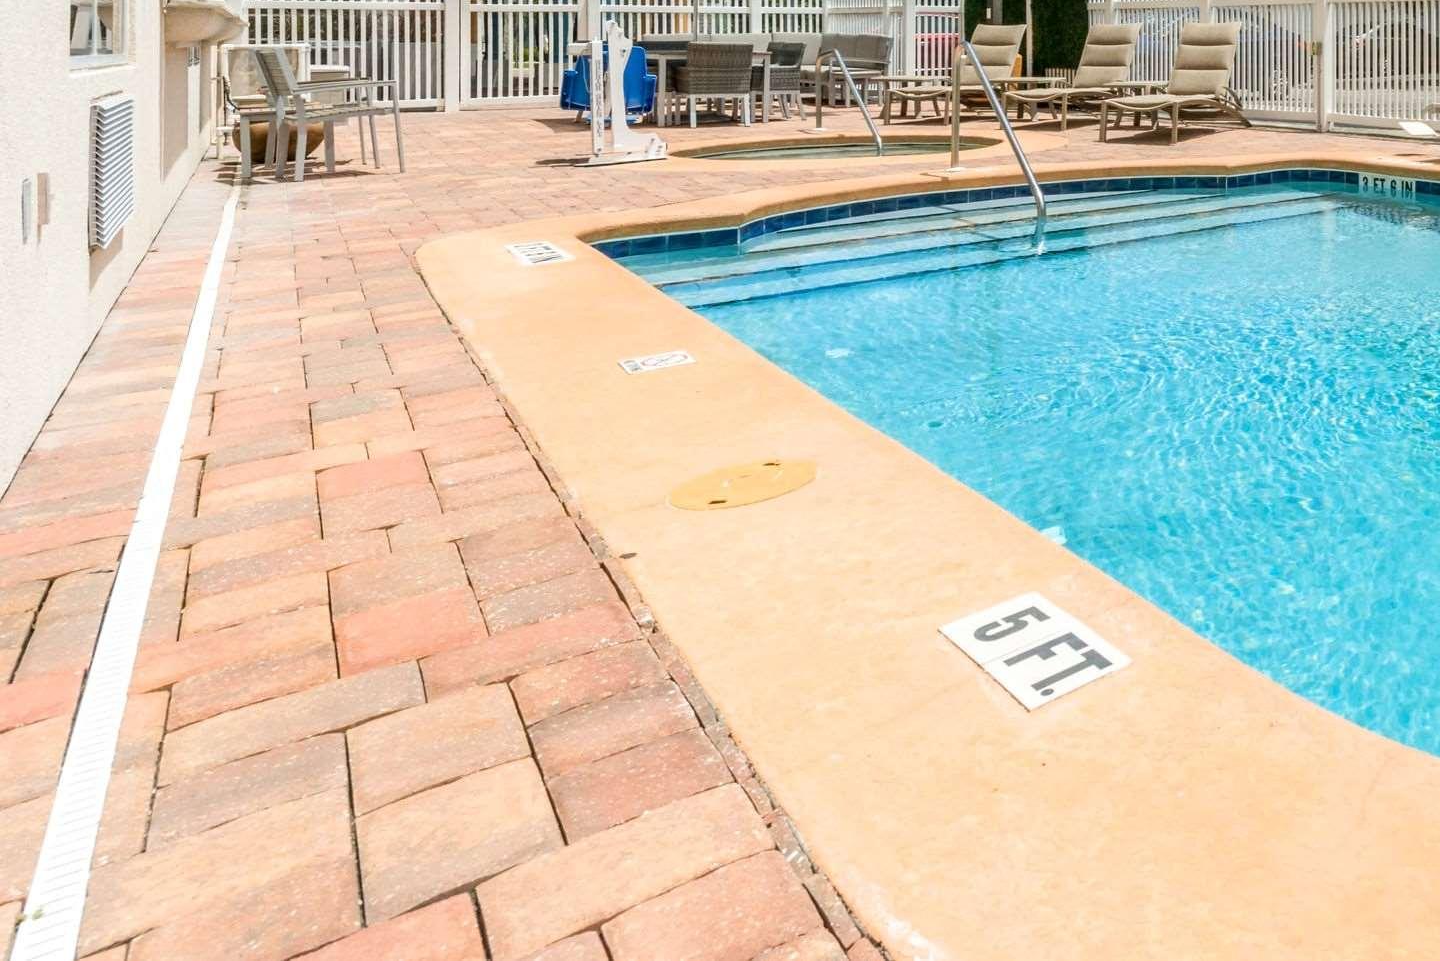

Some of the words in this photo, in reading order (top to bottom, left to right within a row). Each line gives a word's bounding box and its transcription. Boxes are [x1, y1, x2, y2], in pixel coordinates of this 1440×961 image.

[1373, 177, 1386, 189] FT
[1401, 180, 1413, 192] IN
[974, 606, 1051, 642] 5
